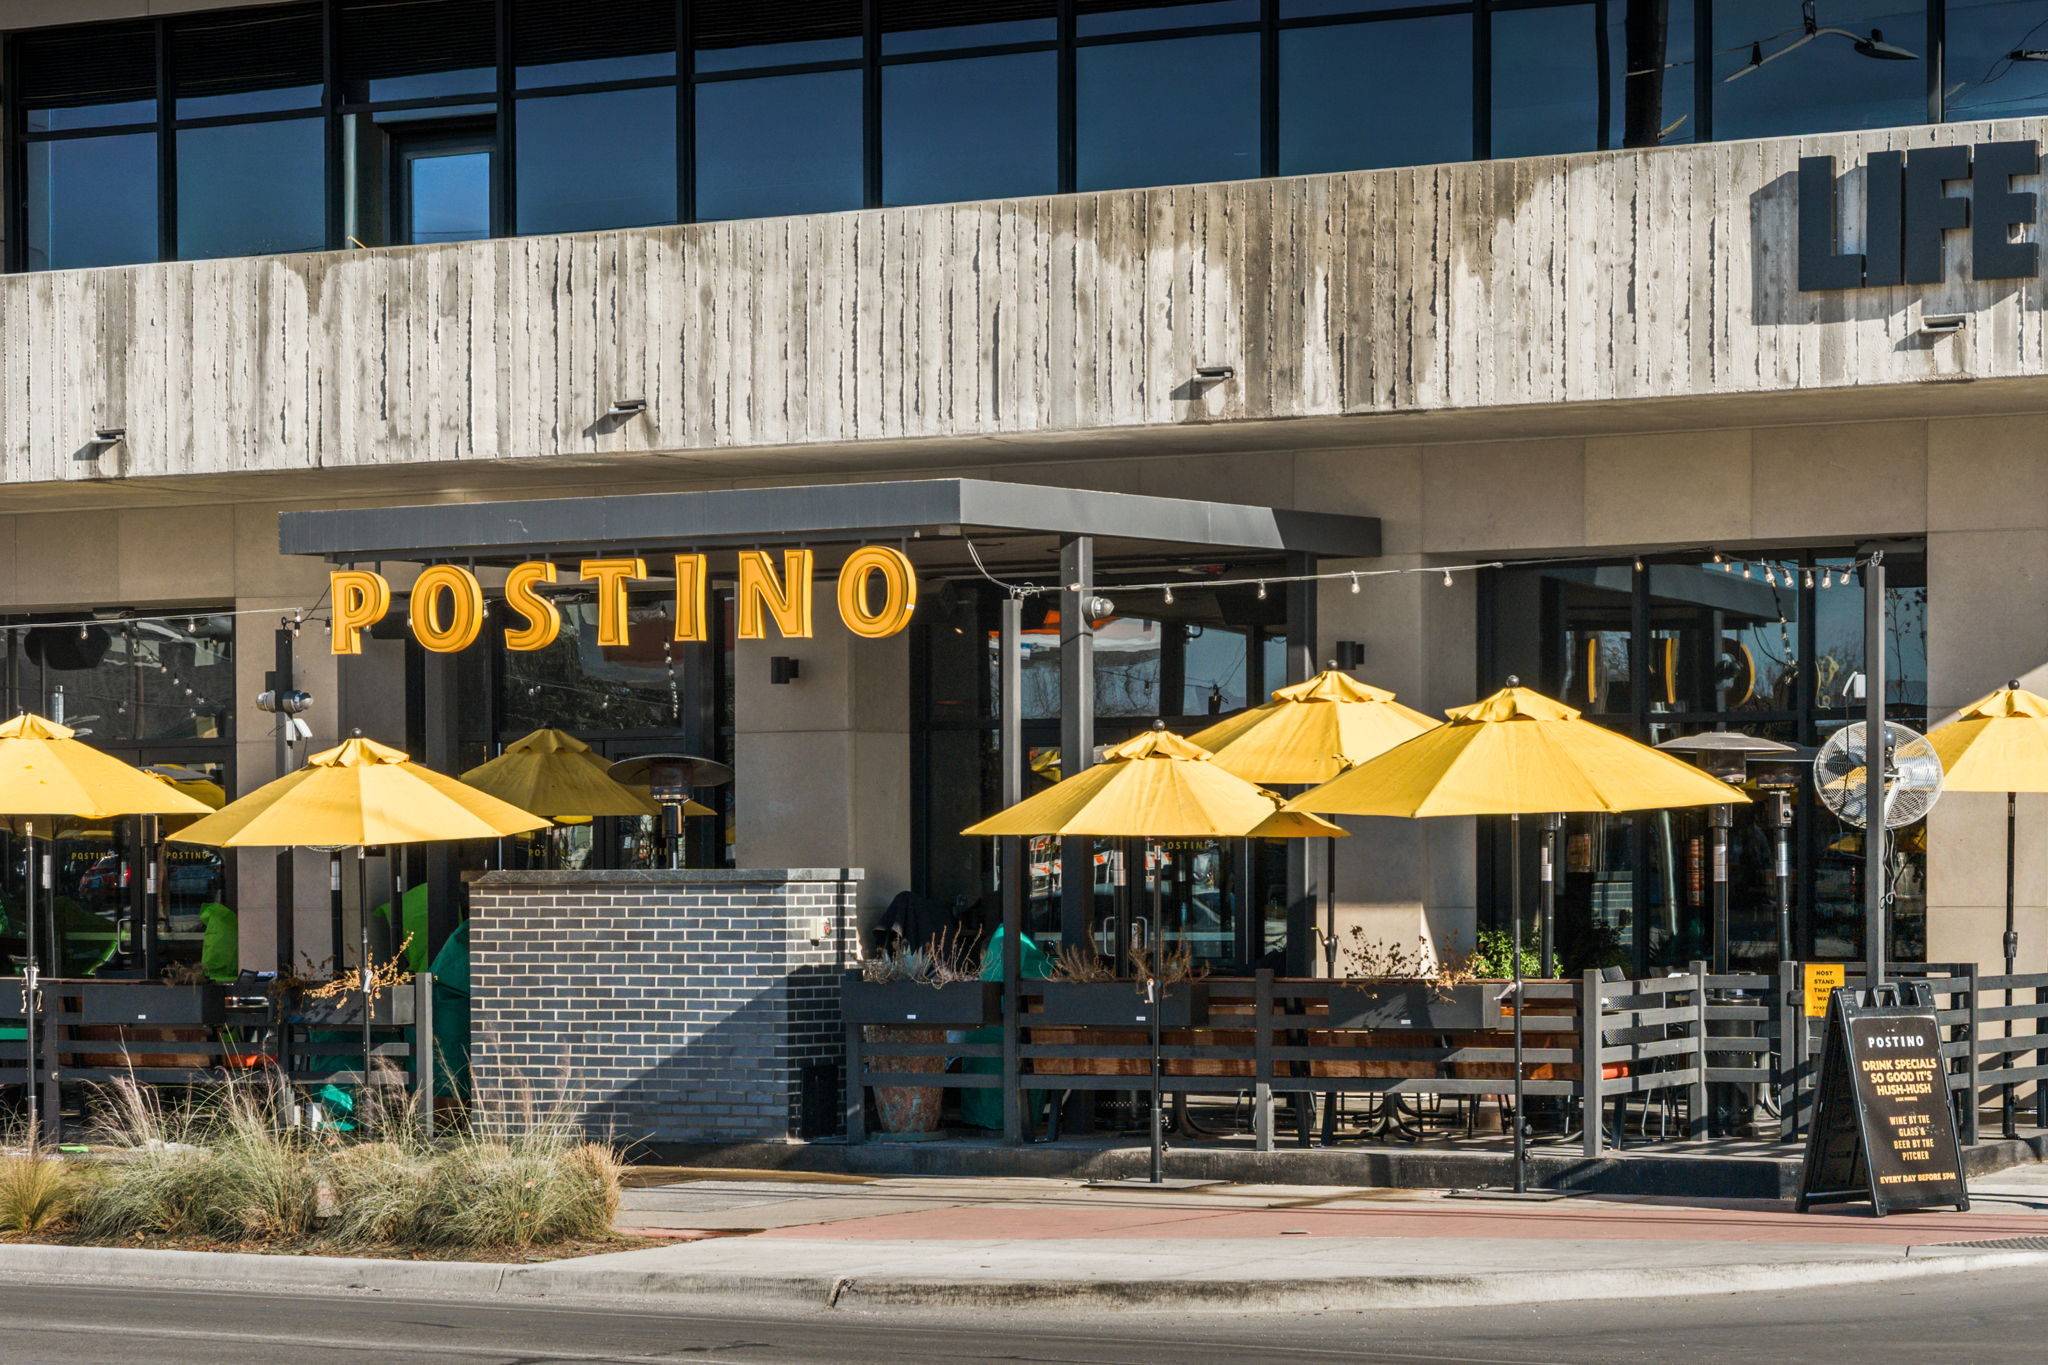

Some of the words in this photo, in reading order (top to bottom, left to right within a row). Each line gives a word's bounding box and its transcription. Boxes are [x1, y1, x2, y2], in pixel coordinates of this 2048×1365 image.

[1798, 139, 2040, 292] LIFE
[330, 545, 917, 656] POSTINO
[527, 848, 573, 857] POSINO
[1867, 1035, 1924, 1048] POSTINO
[1862, 1059, 1893, 1071] DRINK
[1894, 1058, 1937, 1070] SPECIALS
[1870, 1072, 1885, 1084] SO
[1886, 1071, 1915, 1083] GOOD
[1916, 1070, 1933, 1081] IT'S
[1876, 1083, 1932, 1096] HUSH-HUSH
[1889, 1115, 1908, 1125] WINE
[1908, 1115, 1917, 1124] BY
[1917, 1114, 1931, 1124] THE
[1898, 1127, 1919, 1137] GLASS
[1893, 1139, 1911, 1149] BEER
[1912, 1139, 1921, 1148] BY
[1921, 1138, 1935, 1148] THE
[1902, 1151, 1930, 1160] PITCHER
[1880, 1175, 1902, 1184] EVERY
[1902, 1174, 1917, 1183] DAY
[1917, 1172, 1942, 1182] BEFORE
[1942, 1171, 1956, 1180] 5PM
